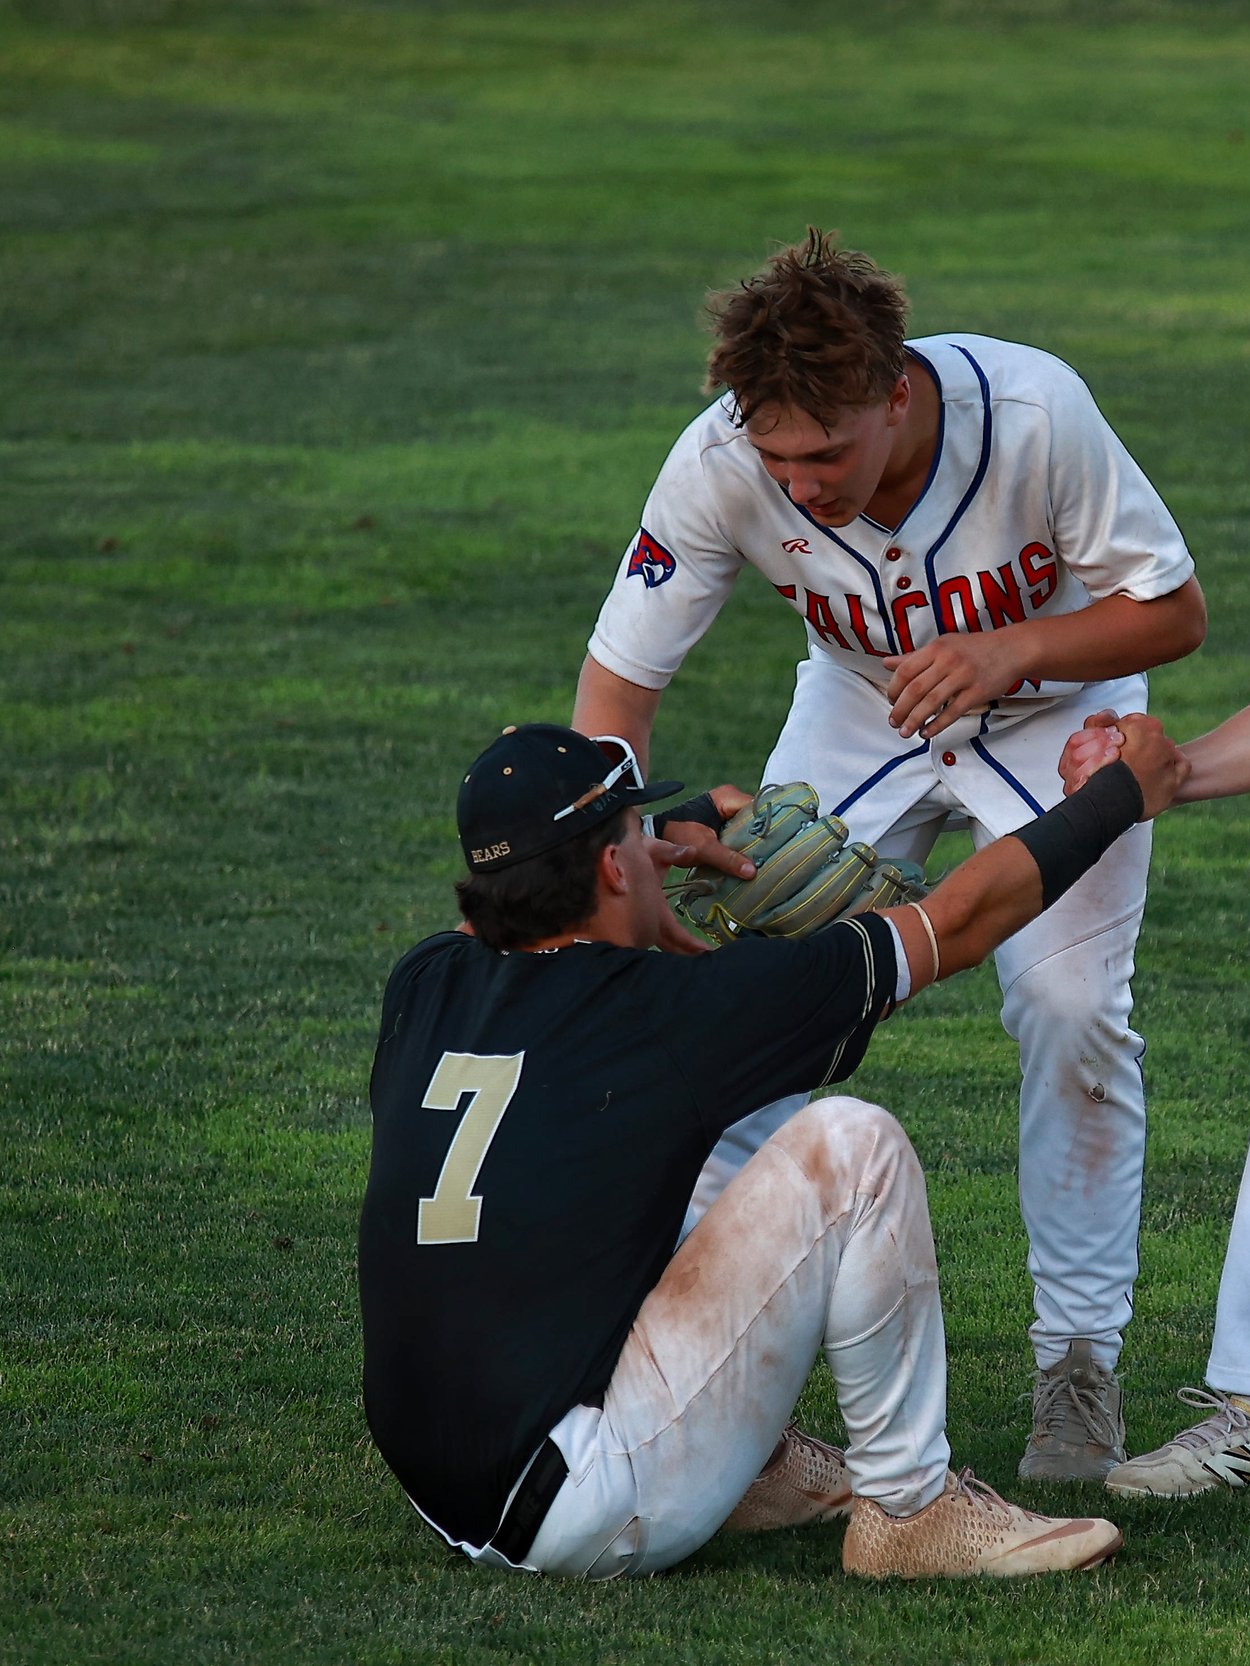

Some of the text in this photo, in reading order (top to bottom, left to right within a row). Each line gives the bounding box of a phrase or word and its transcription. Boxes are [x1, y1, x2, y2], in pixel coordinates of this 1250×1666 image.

[771, 541, 1055, 657] ALCONS
[471, 841, 511, 863] BEARS
[416, 1050, 526, 1245] 7
